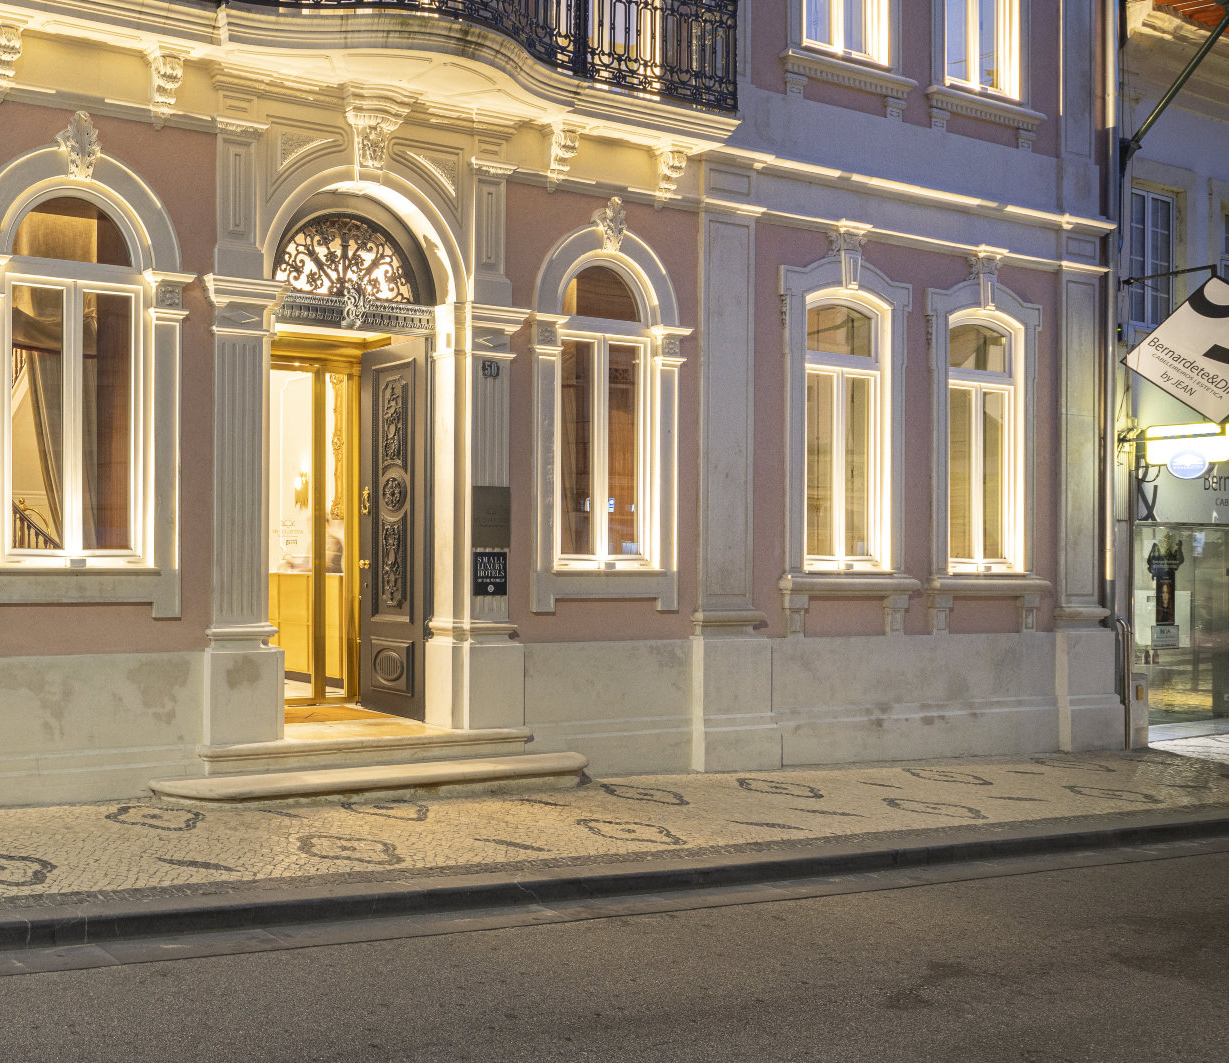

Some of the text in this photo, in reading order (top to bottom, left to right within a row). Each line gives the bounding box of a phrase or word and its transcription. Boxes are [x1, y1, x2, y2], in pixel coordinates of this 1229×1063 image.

[485, 361, 498, 377] 50
[1160, 371, 1197, 396] by JEAN
[477, 556, 505, 564] SMALL
